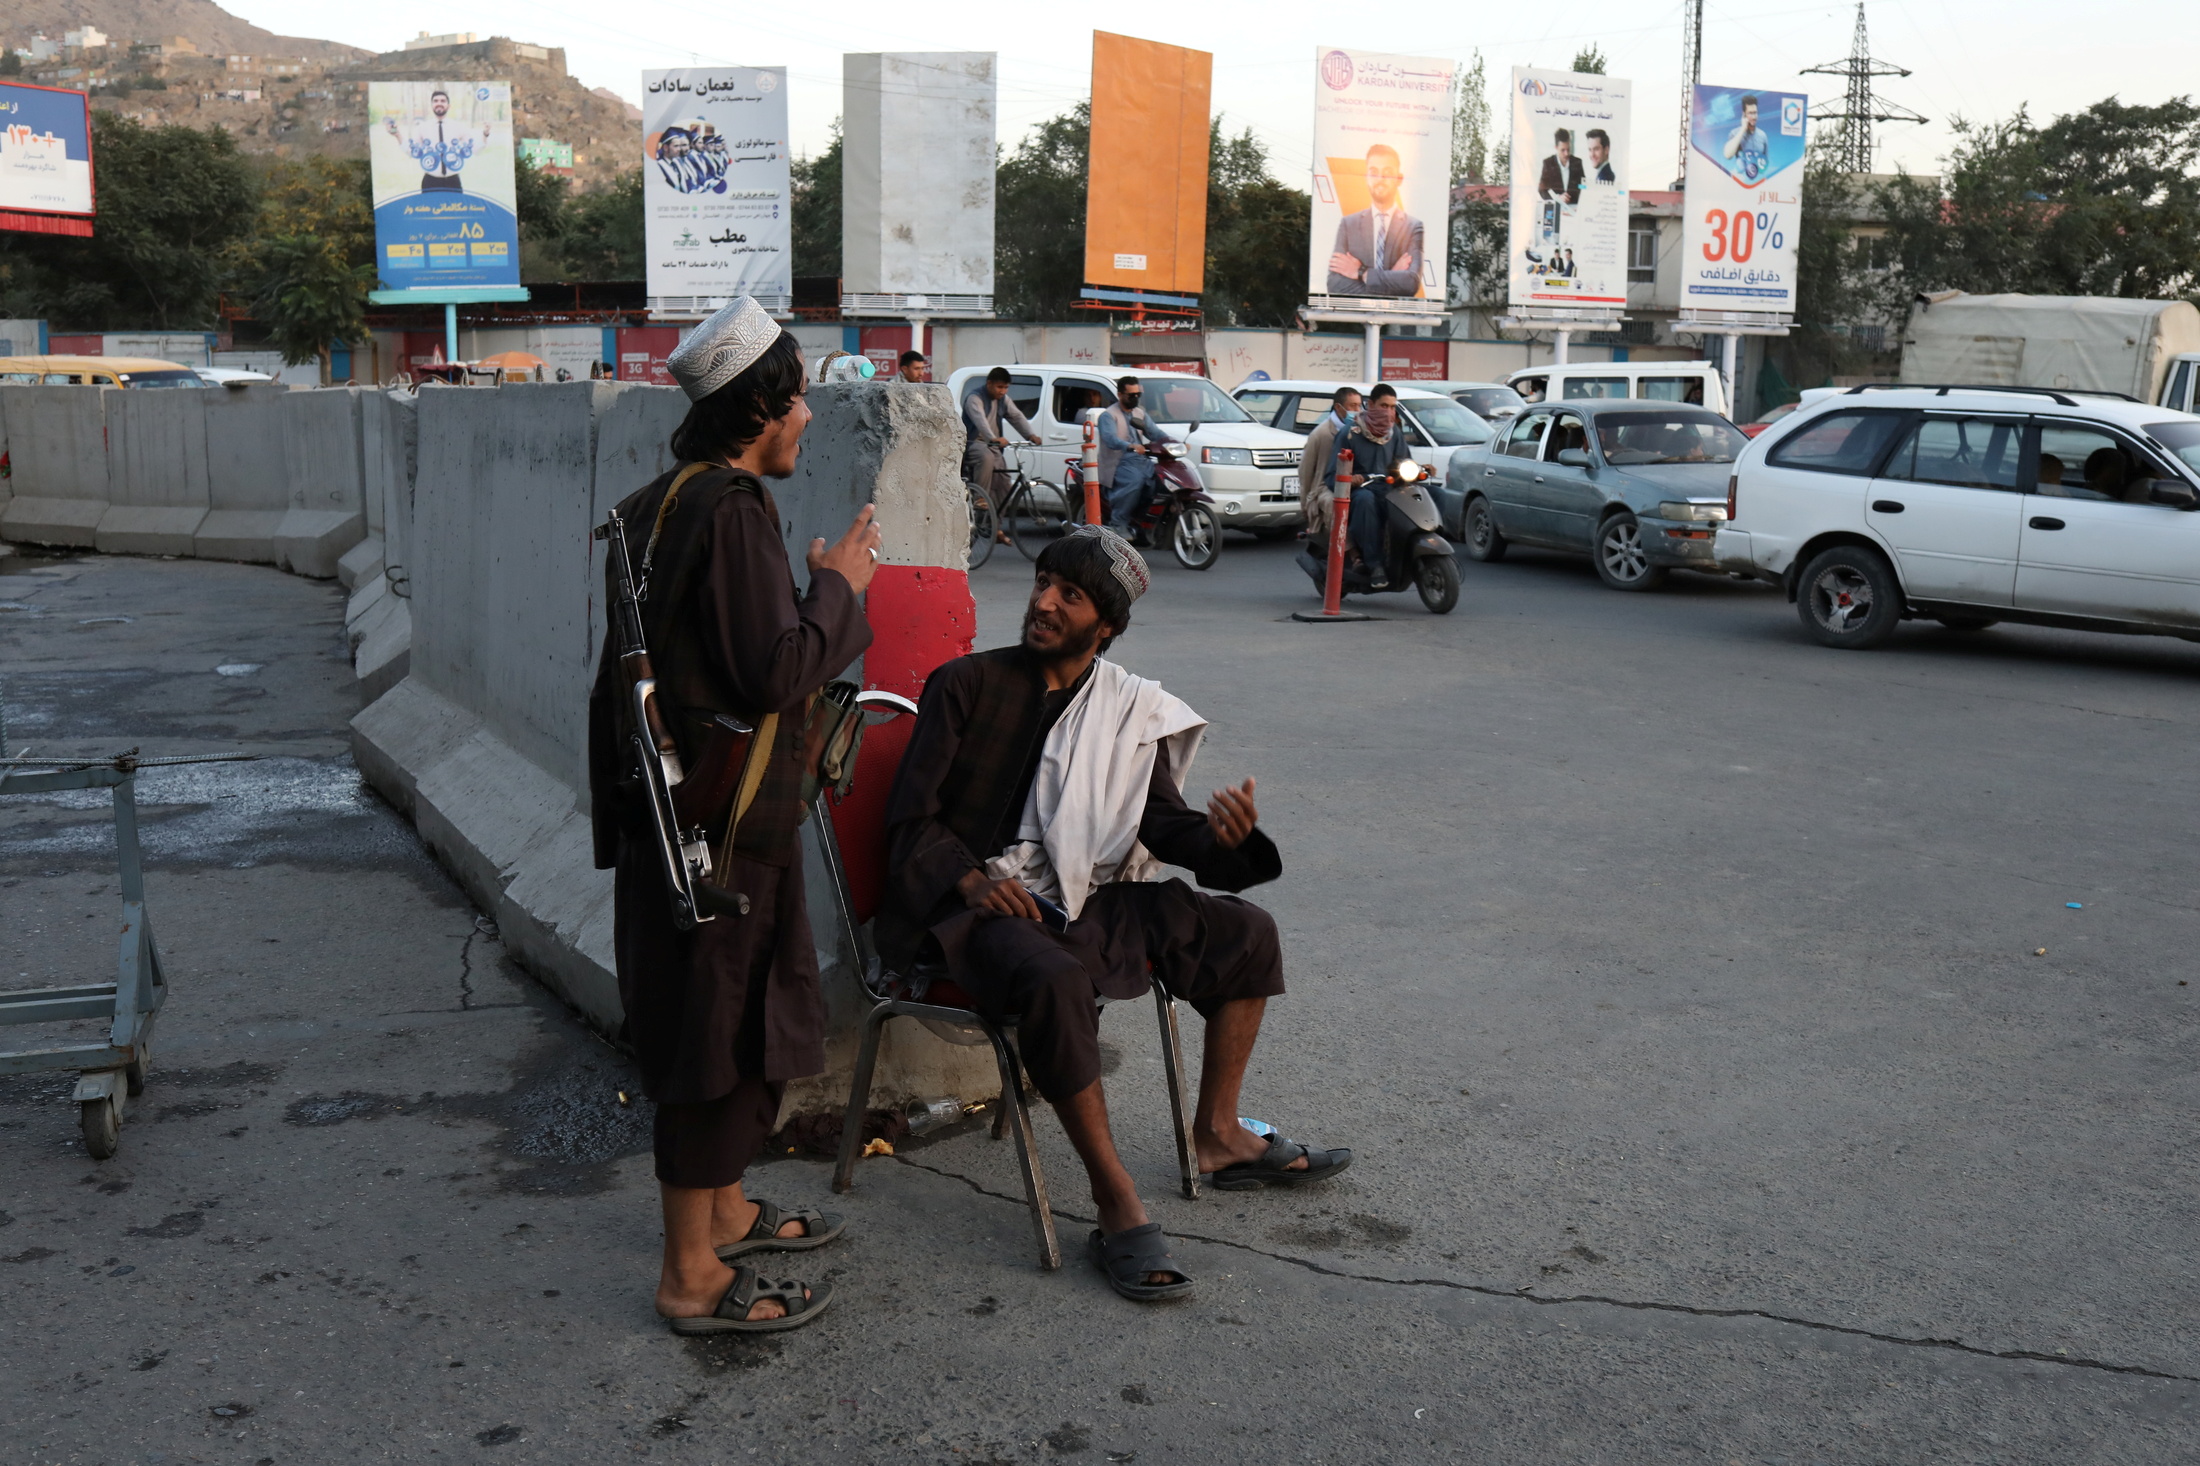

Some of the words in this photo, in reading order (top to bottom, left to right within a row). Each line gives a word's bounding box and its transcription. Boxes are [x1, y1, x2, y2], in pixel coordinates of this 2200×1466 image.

[1357, 62, 1392, 76] کاردان
[648, 78, 692, 93] سادات
[695, 76, 735, 96] نعمان
[1357, 77, 1396, 89] KARDAN
[1399, 79, 1451, 94] UNIVERSITY
[1334, 97, 1362, 106] UNLOCK
[1365, 99, 1384, 107] YOUR
[1385, 101, 1411, 110] FUTURE
[1757, 191, 1767, 206] از
[459, 221, 485, 239] ۸۵
[709, 227, 747, 248] مطب
[1702, 208, 1784, 264] 30%
[1700, 266, 1742, 281] اضافی
[1744, 269, 1781, 285] دقایق
[628, 363, 643, 374] 3G
[1411, 372, 1443, 380] ROSHAN
